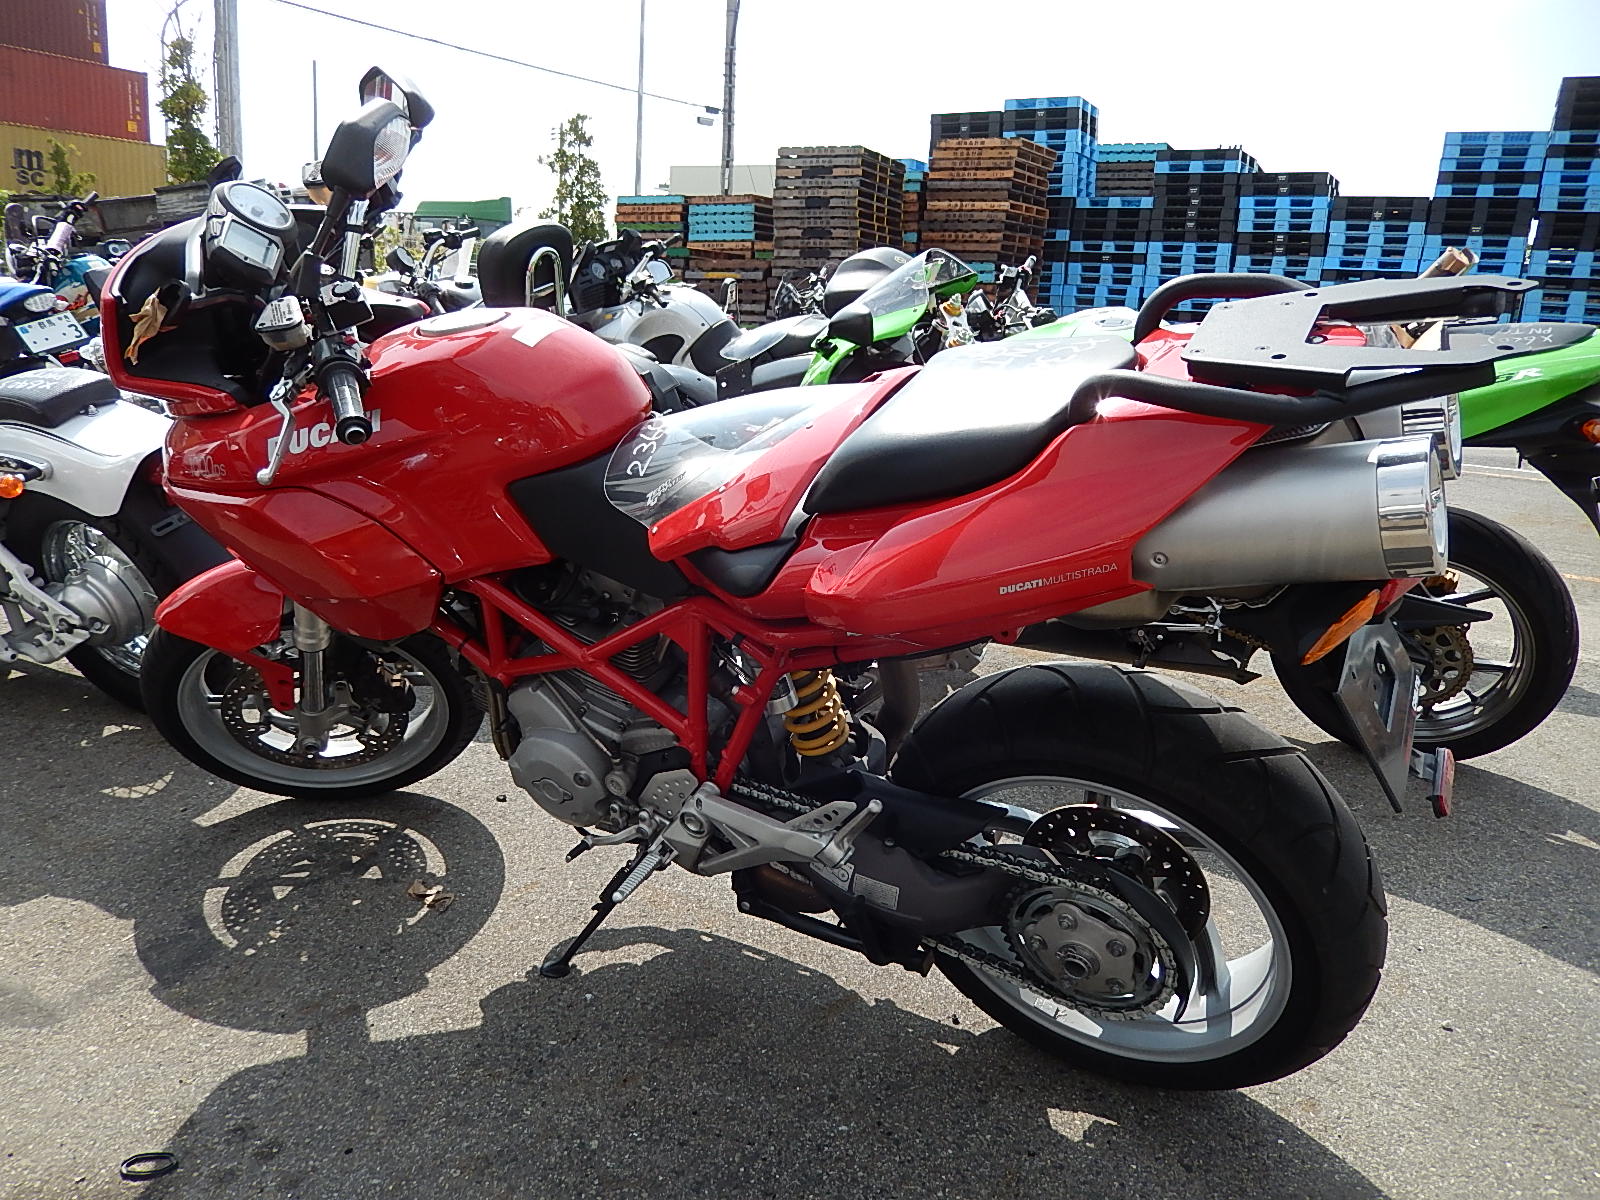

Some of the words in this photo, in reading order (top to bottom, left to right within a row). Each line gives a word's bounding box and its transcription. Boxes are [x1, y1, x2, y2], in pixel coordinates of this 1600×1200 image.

[267, 408, 382, 462] DUCI
[999, 578, 1043, 595] DUCATI
[1043, 562, 1118, 586] MULTISTRADA
